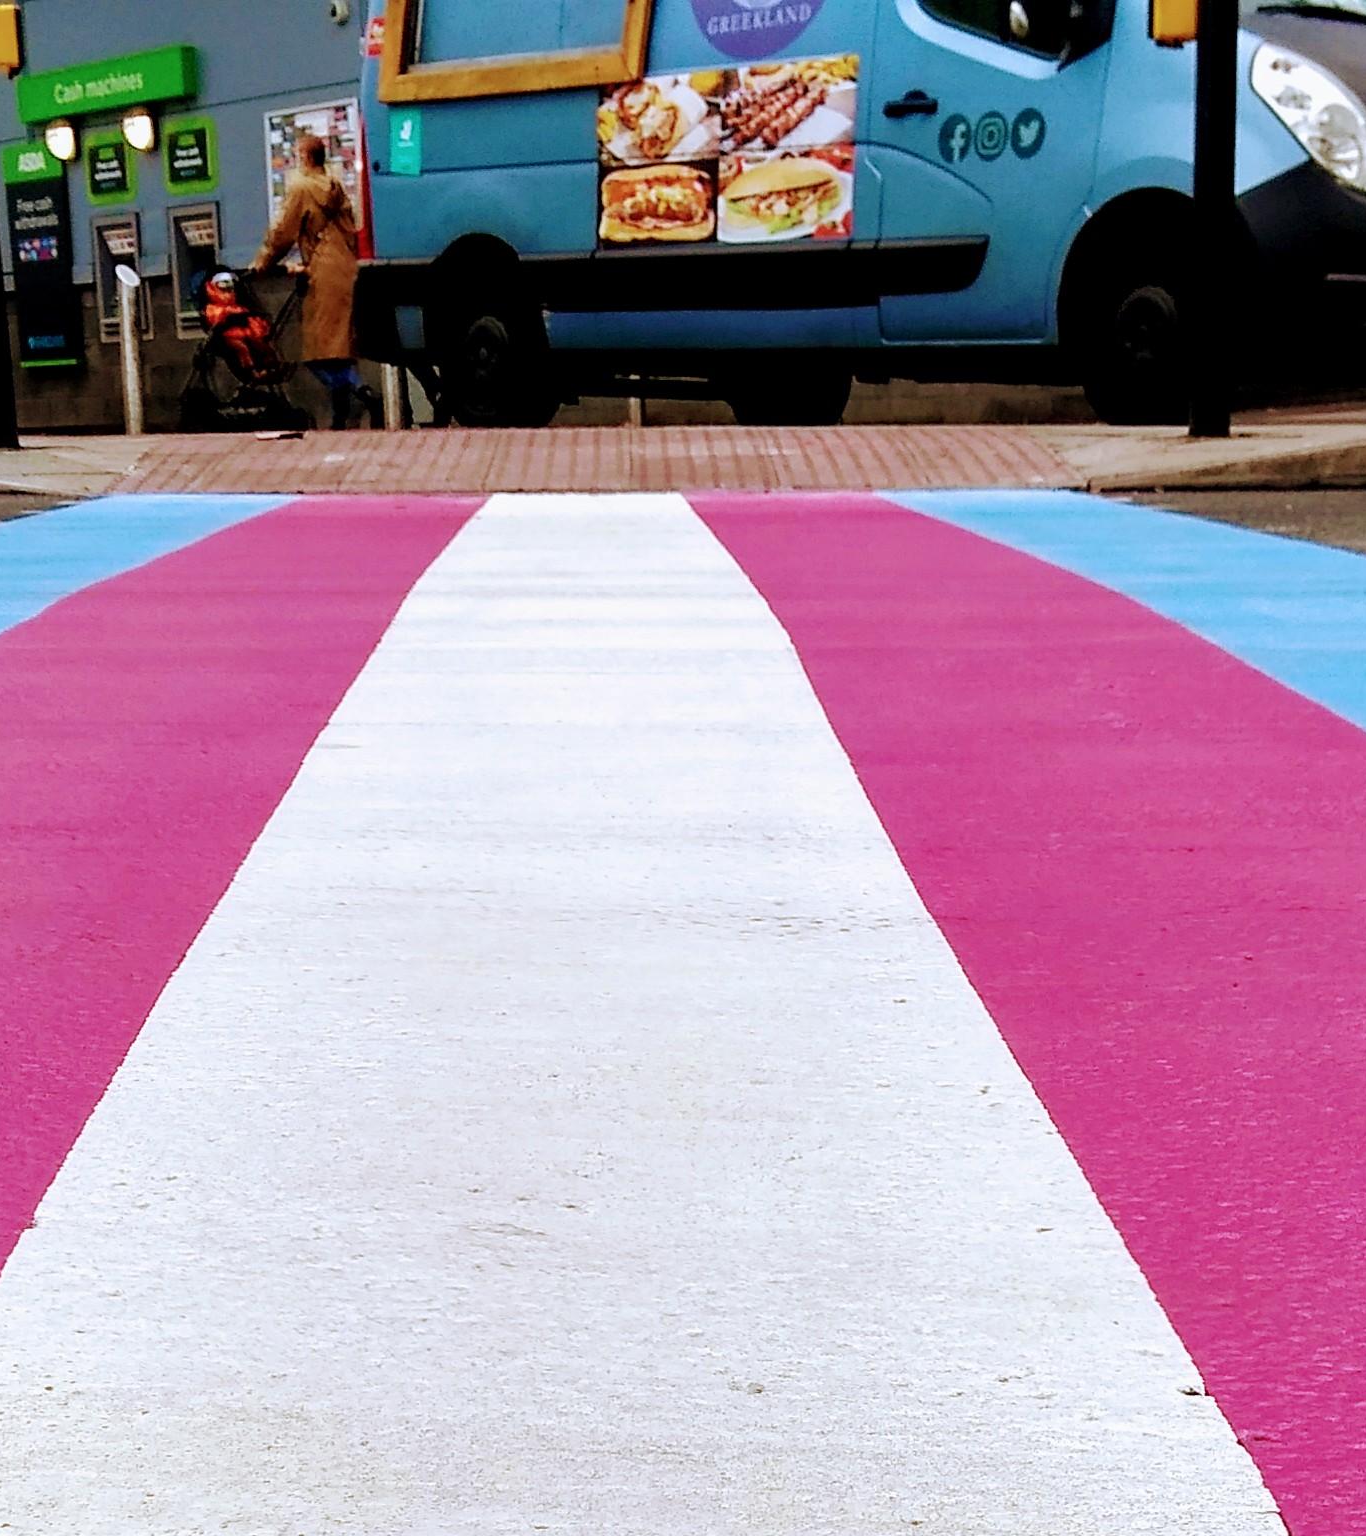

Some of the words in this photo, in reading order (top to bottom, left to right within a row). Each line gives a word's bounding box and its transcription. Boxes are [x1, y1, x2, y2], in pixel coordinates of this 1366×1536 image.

[706, 3, 812, 35] GREEKLAND
[53, 80, 84, 104] Cash
[85, 72, 144, 98] machines
